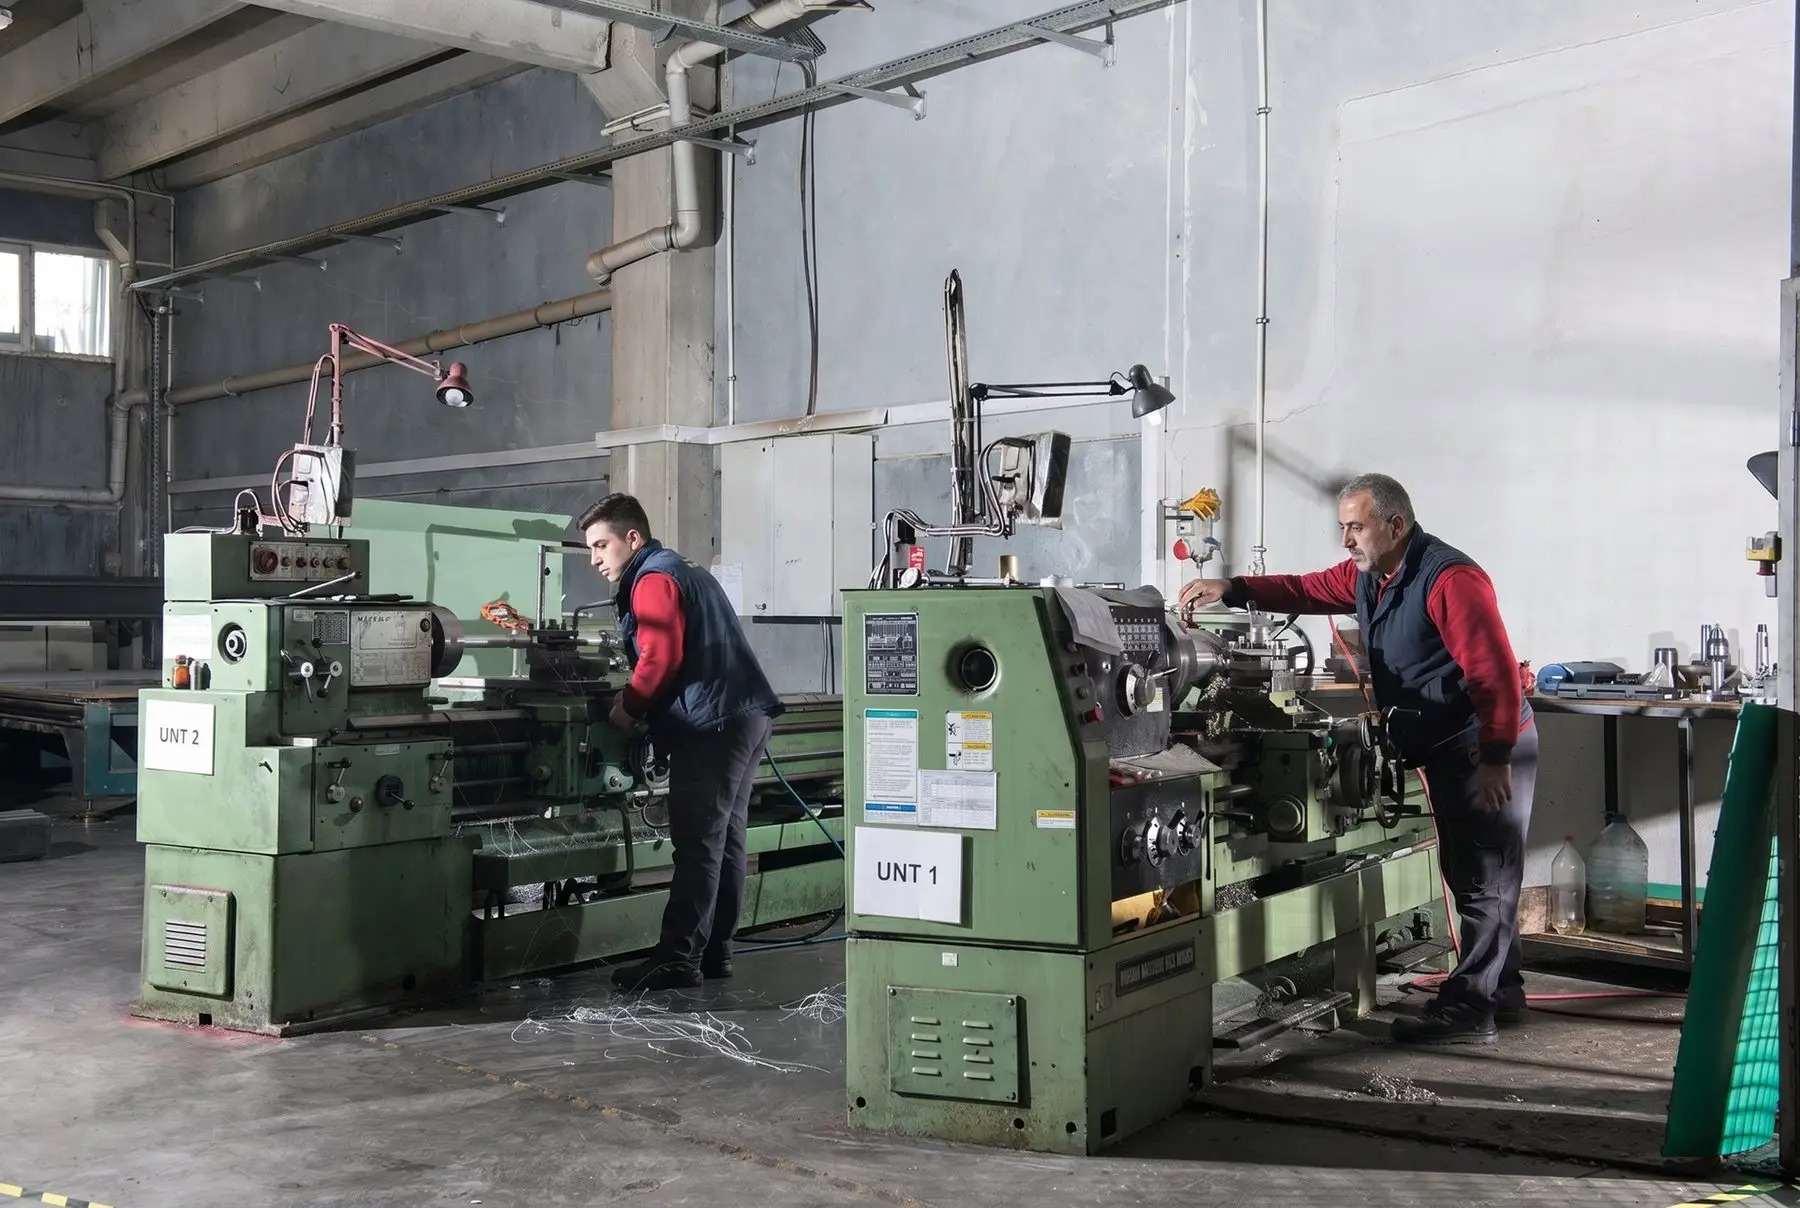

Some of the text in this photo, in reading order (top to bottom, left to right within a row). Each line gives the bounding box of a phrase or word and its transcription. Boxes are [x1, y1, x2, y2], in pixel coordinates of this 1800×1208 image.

[160, 727, 199, 745] UNT 2
[877, 861, 937, 885] UNT 1
